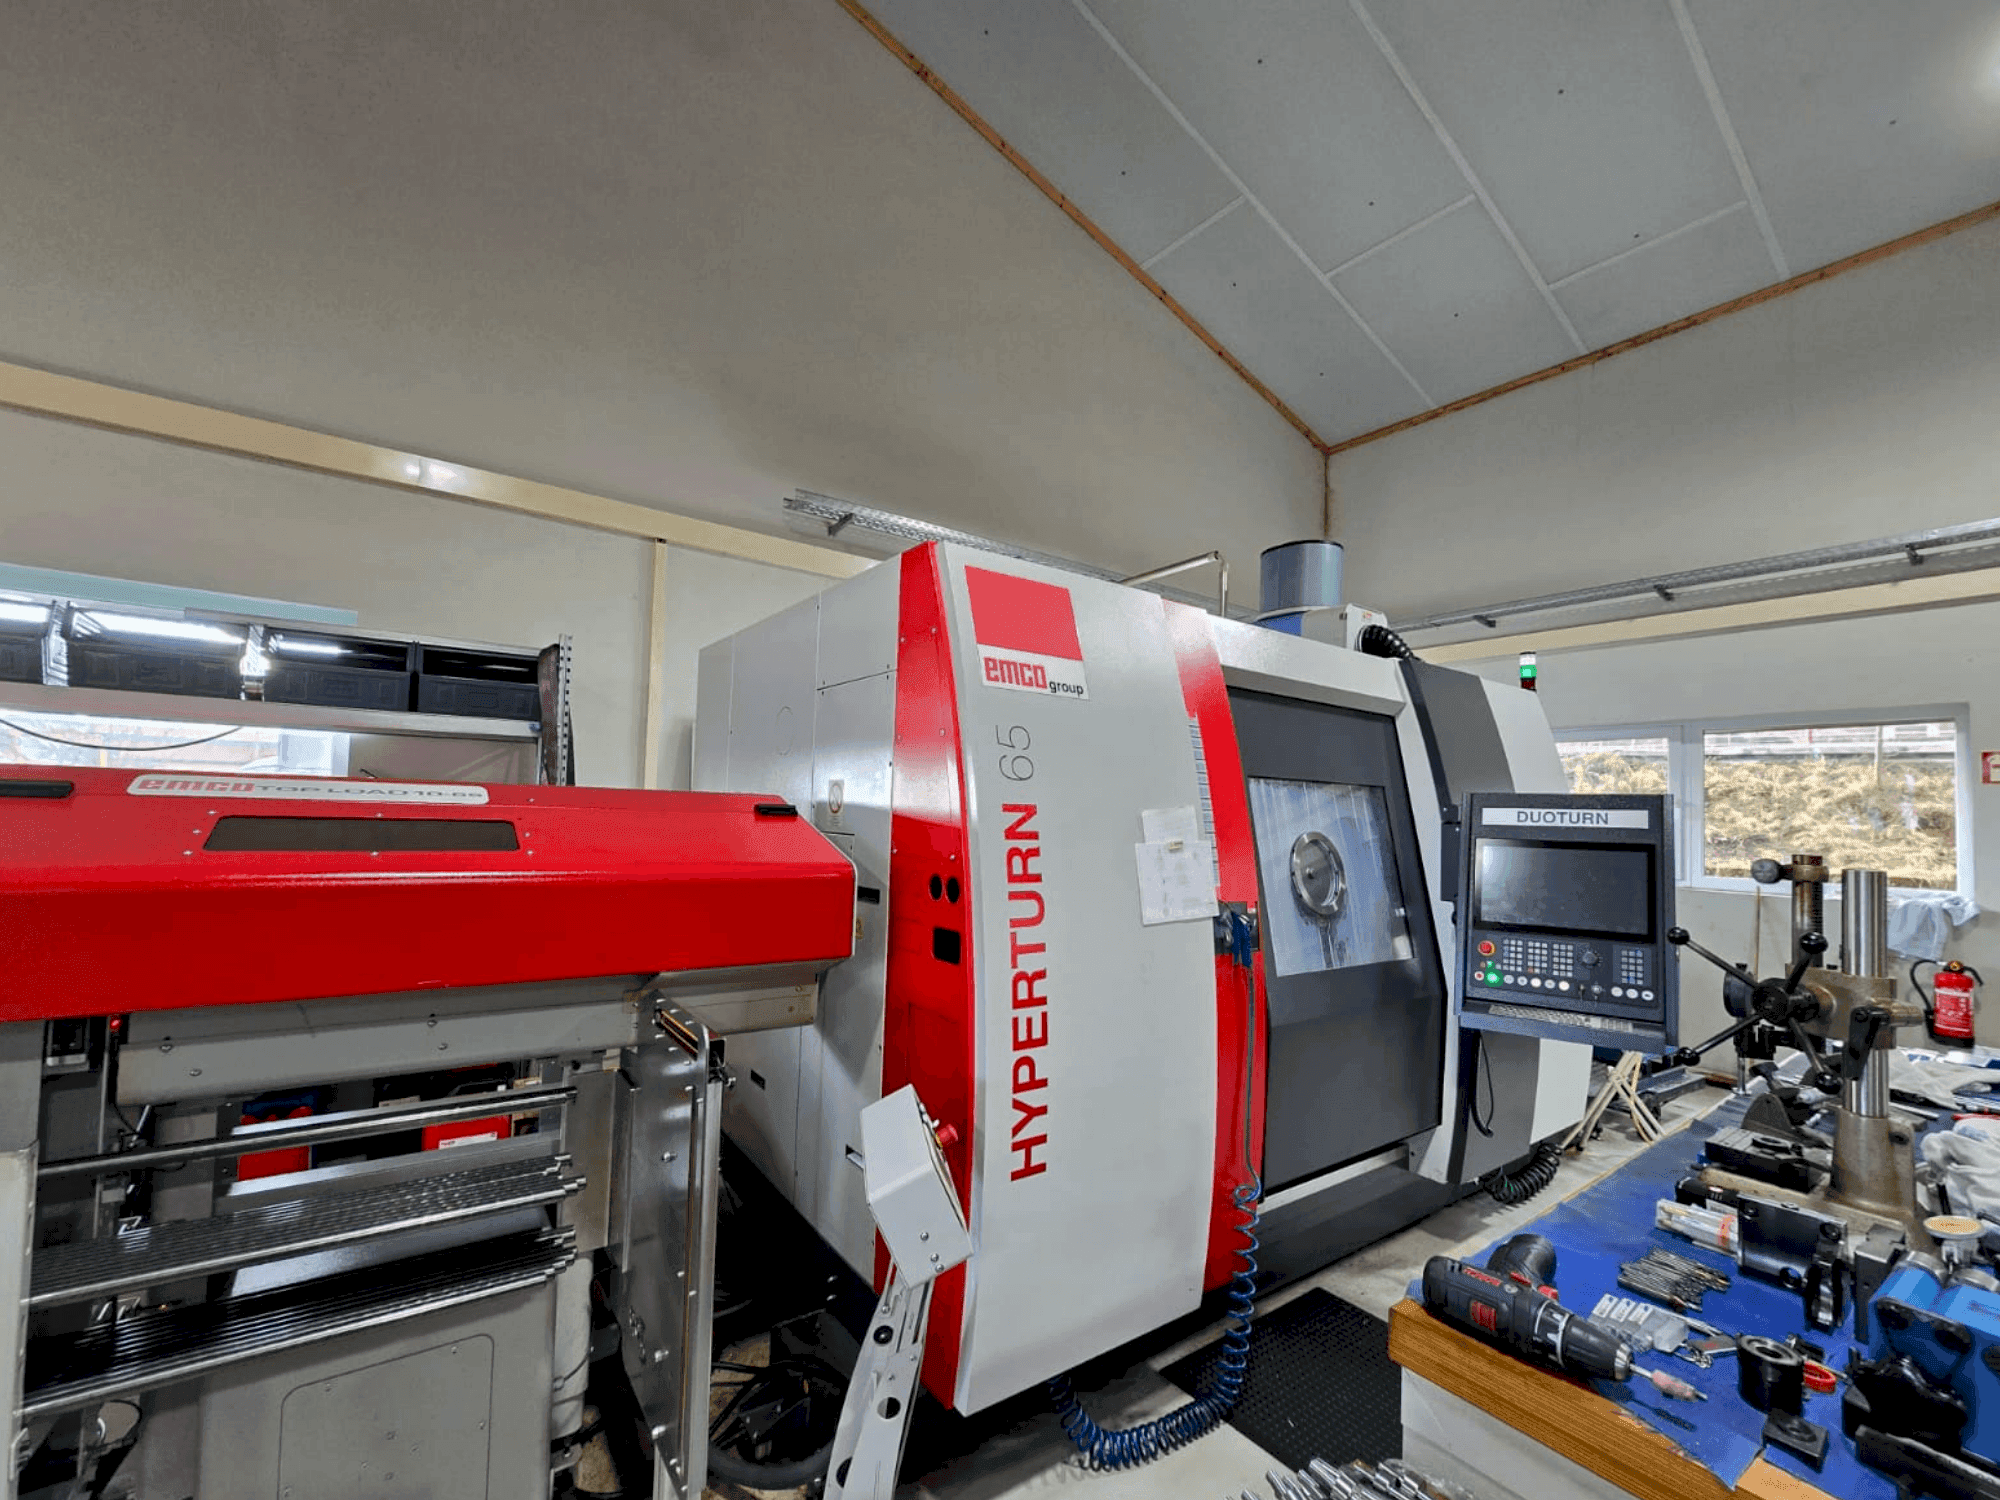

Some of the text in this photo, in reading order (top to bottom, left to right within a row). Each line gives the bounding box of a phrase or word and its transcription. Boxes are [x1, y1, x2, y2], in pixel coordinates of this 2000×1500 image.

[983, 657, 1048, 689] emco
[1049, 681, 1084, 697] group
[138, 780, 255, 793] emco
[256, 785, 321, 793] TOP
[327, 788, 408, 796] LOAD
[1517, 811, 1609, 825] DUOTURN
[996, 724, 1048, 1182] HYPERTURN 65
